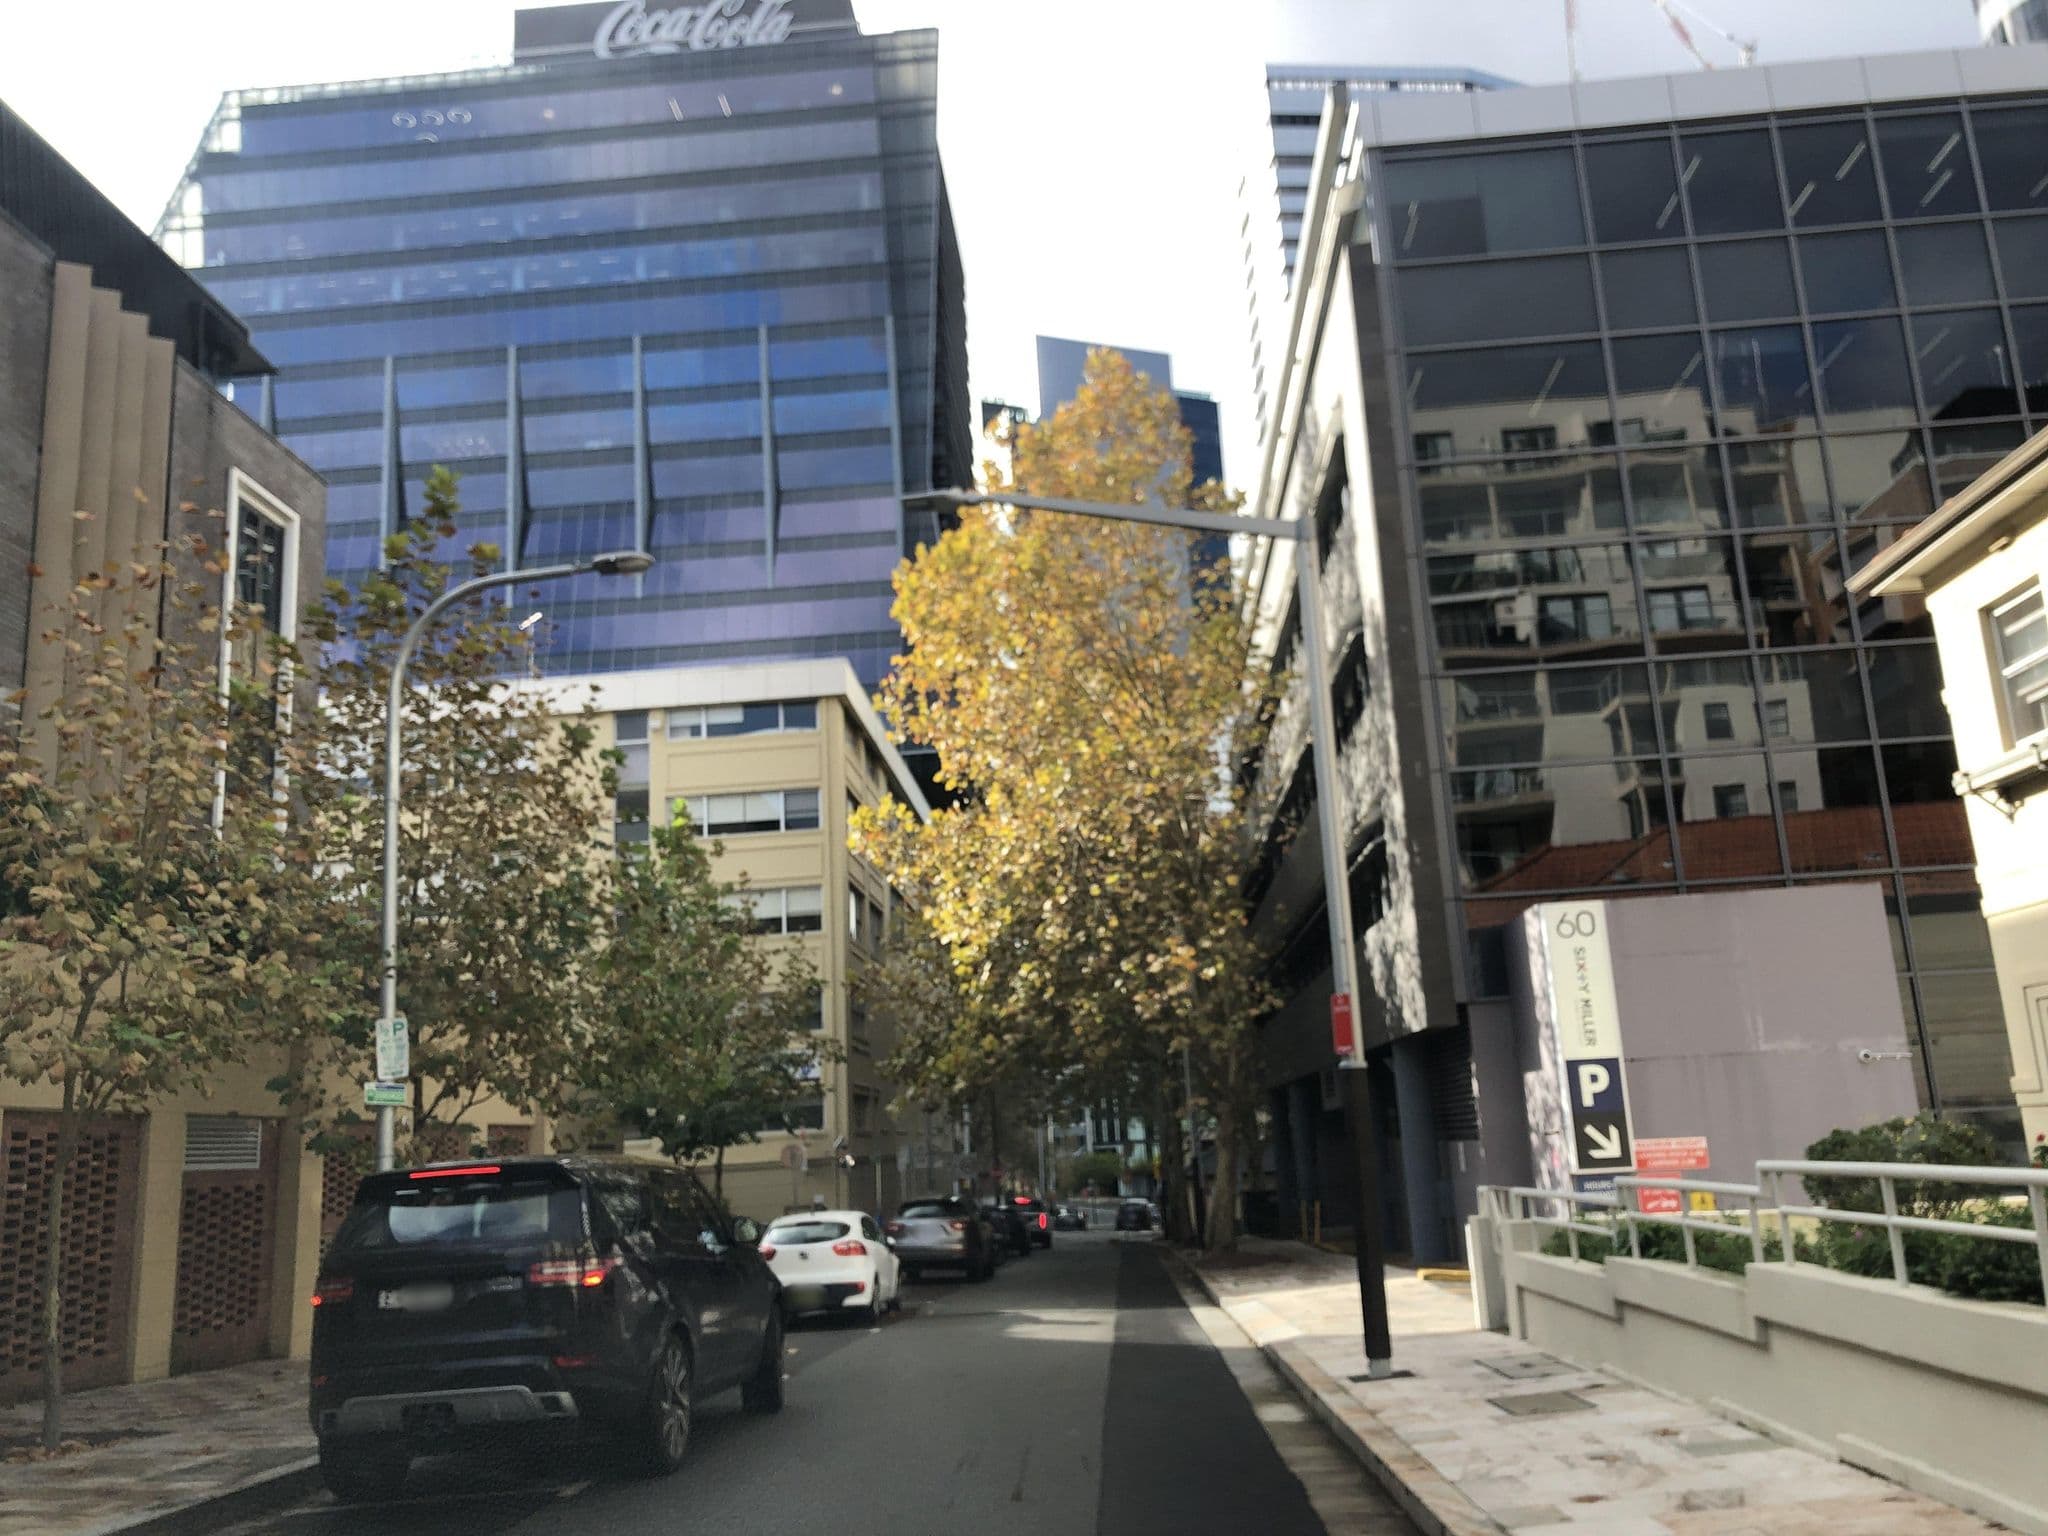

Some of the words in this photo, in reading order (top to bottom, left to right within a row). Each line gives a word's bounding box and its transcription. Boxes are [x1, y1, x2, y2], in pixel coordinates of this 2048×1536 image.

[1556, 910, 1596, 939] 60
[1580, 998, 1597, 1047] MILLER
[1577, 1063, 1610, 1108] P
